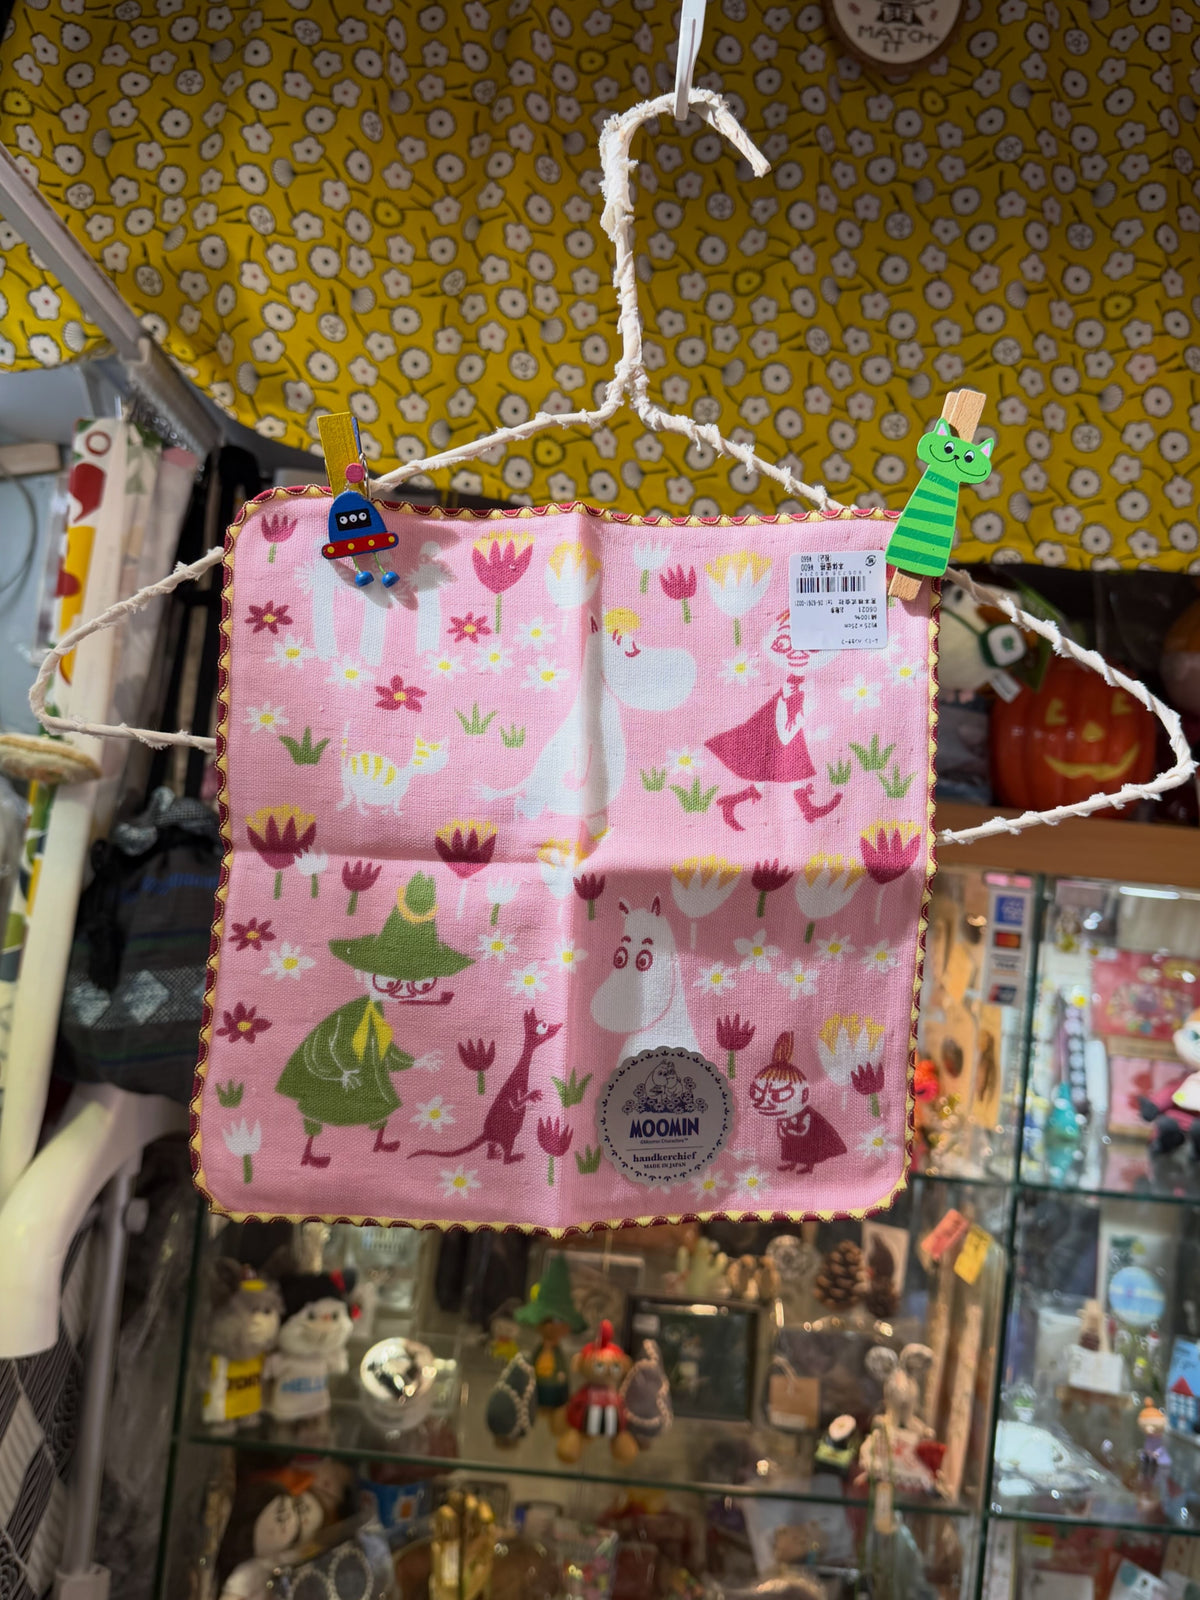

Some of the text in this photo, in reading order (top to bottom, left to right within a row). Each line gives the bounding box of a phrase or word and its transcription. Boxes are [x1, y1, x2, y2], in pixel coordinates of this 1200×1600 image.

[857, 25, 939, 44] MATCH
[882, 40, 904, 53] IT
[629, 1117, 699, 1138] MOOMIN
[633, 1151, 697, 1162] handkerchief
